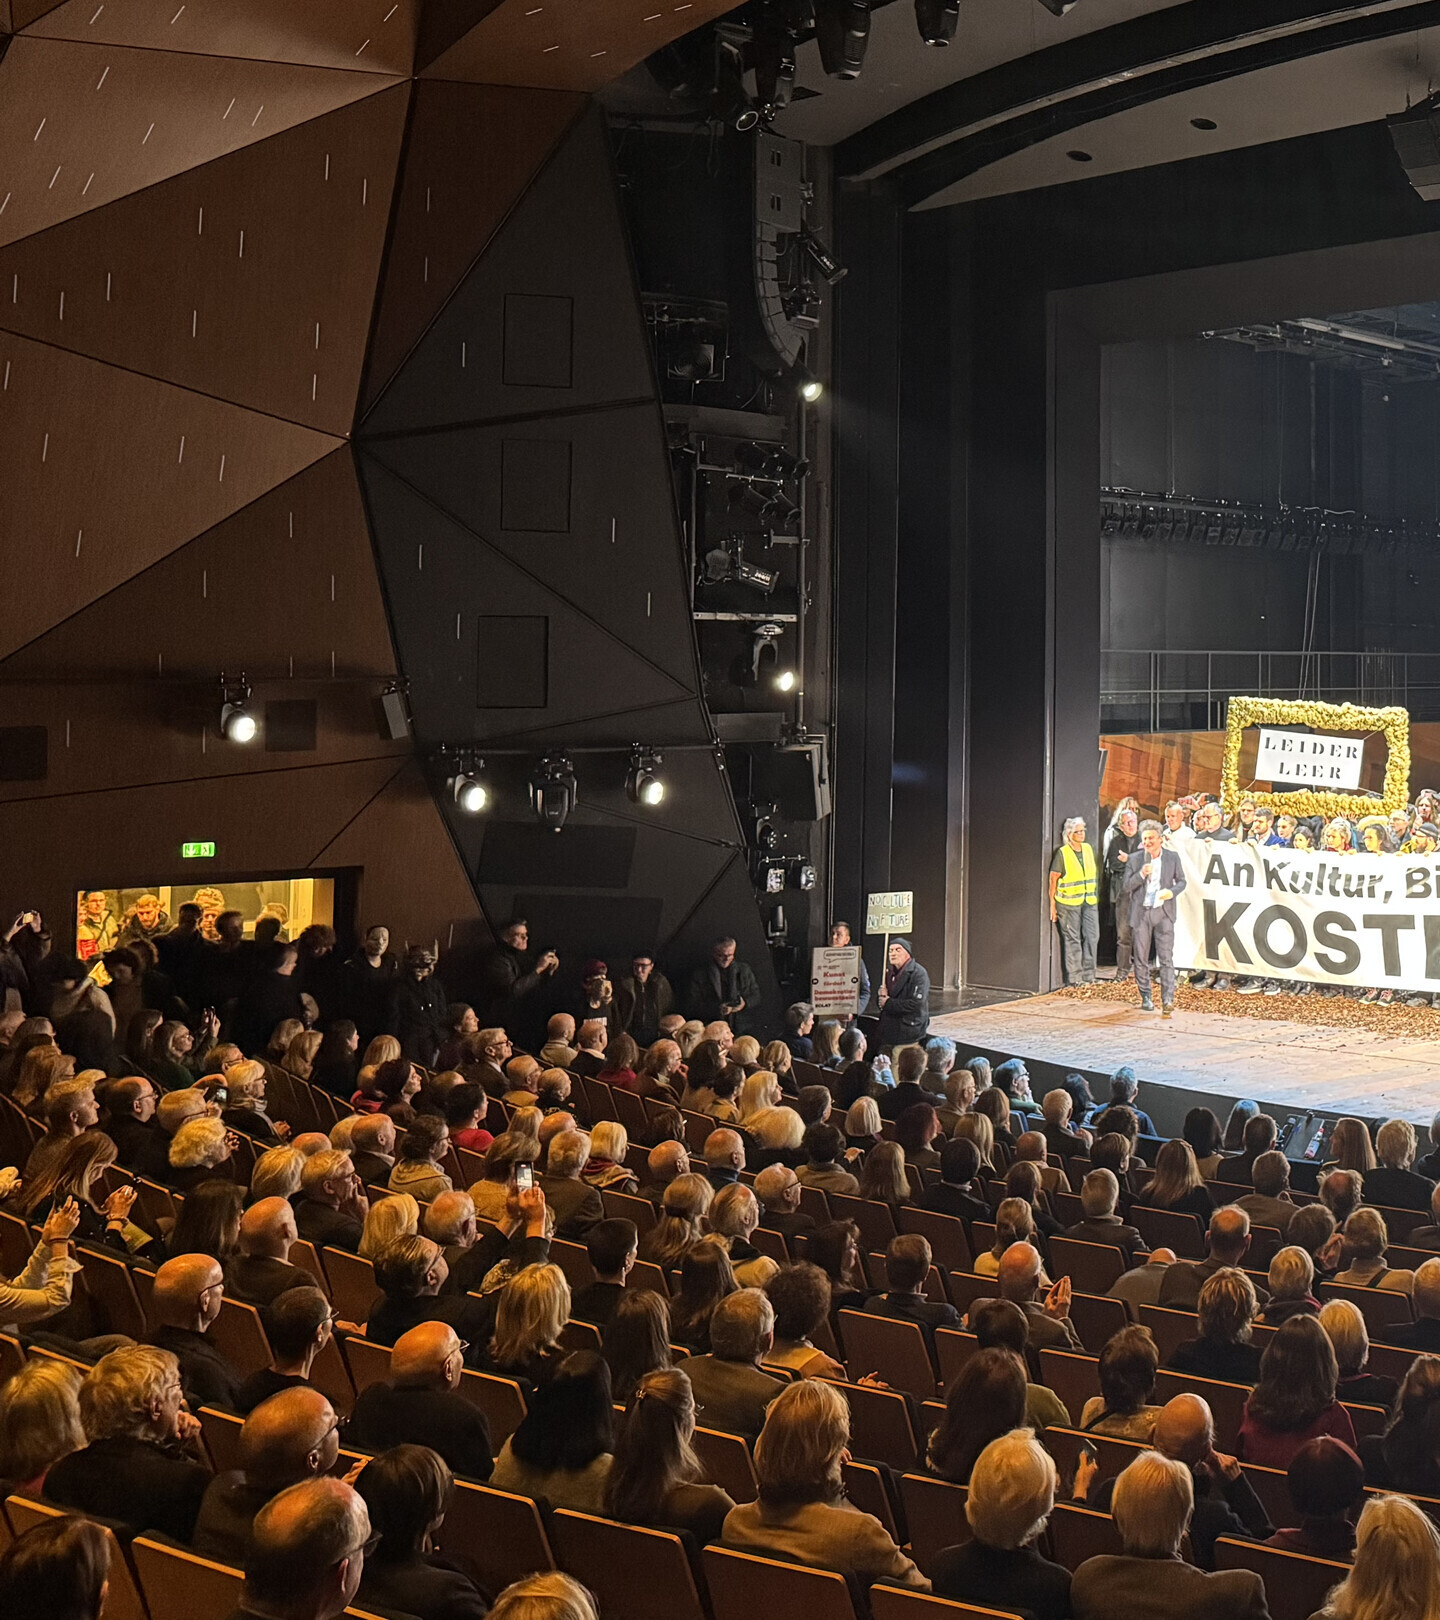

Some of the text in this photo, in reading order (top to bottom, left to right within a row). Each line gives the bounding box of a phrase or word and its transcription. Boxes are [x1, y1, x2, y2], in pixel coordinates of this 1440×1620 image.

[1265, 737, 1357, 758] LEIDER
[1279, 762, 1342, 780] LEER
[1203, 853, 1254, 888] An
[1265, 858, 1393, 904] Kultur,
[870, 894, 910, 908] NO CLTUE
[880, 914, 909, 926] FTURE
